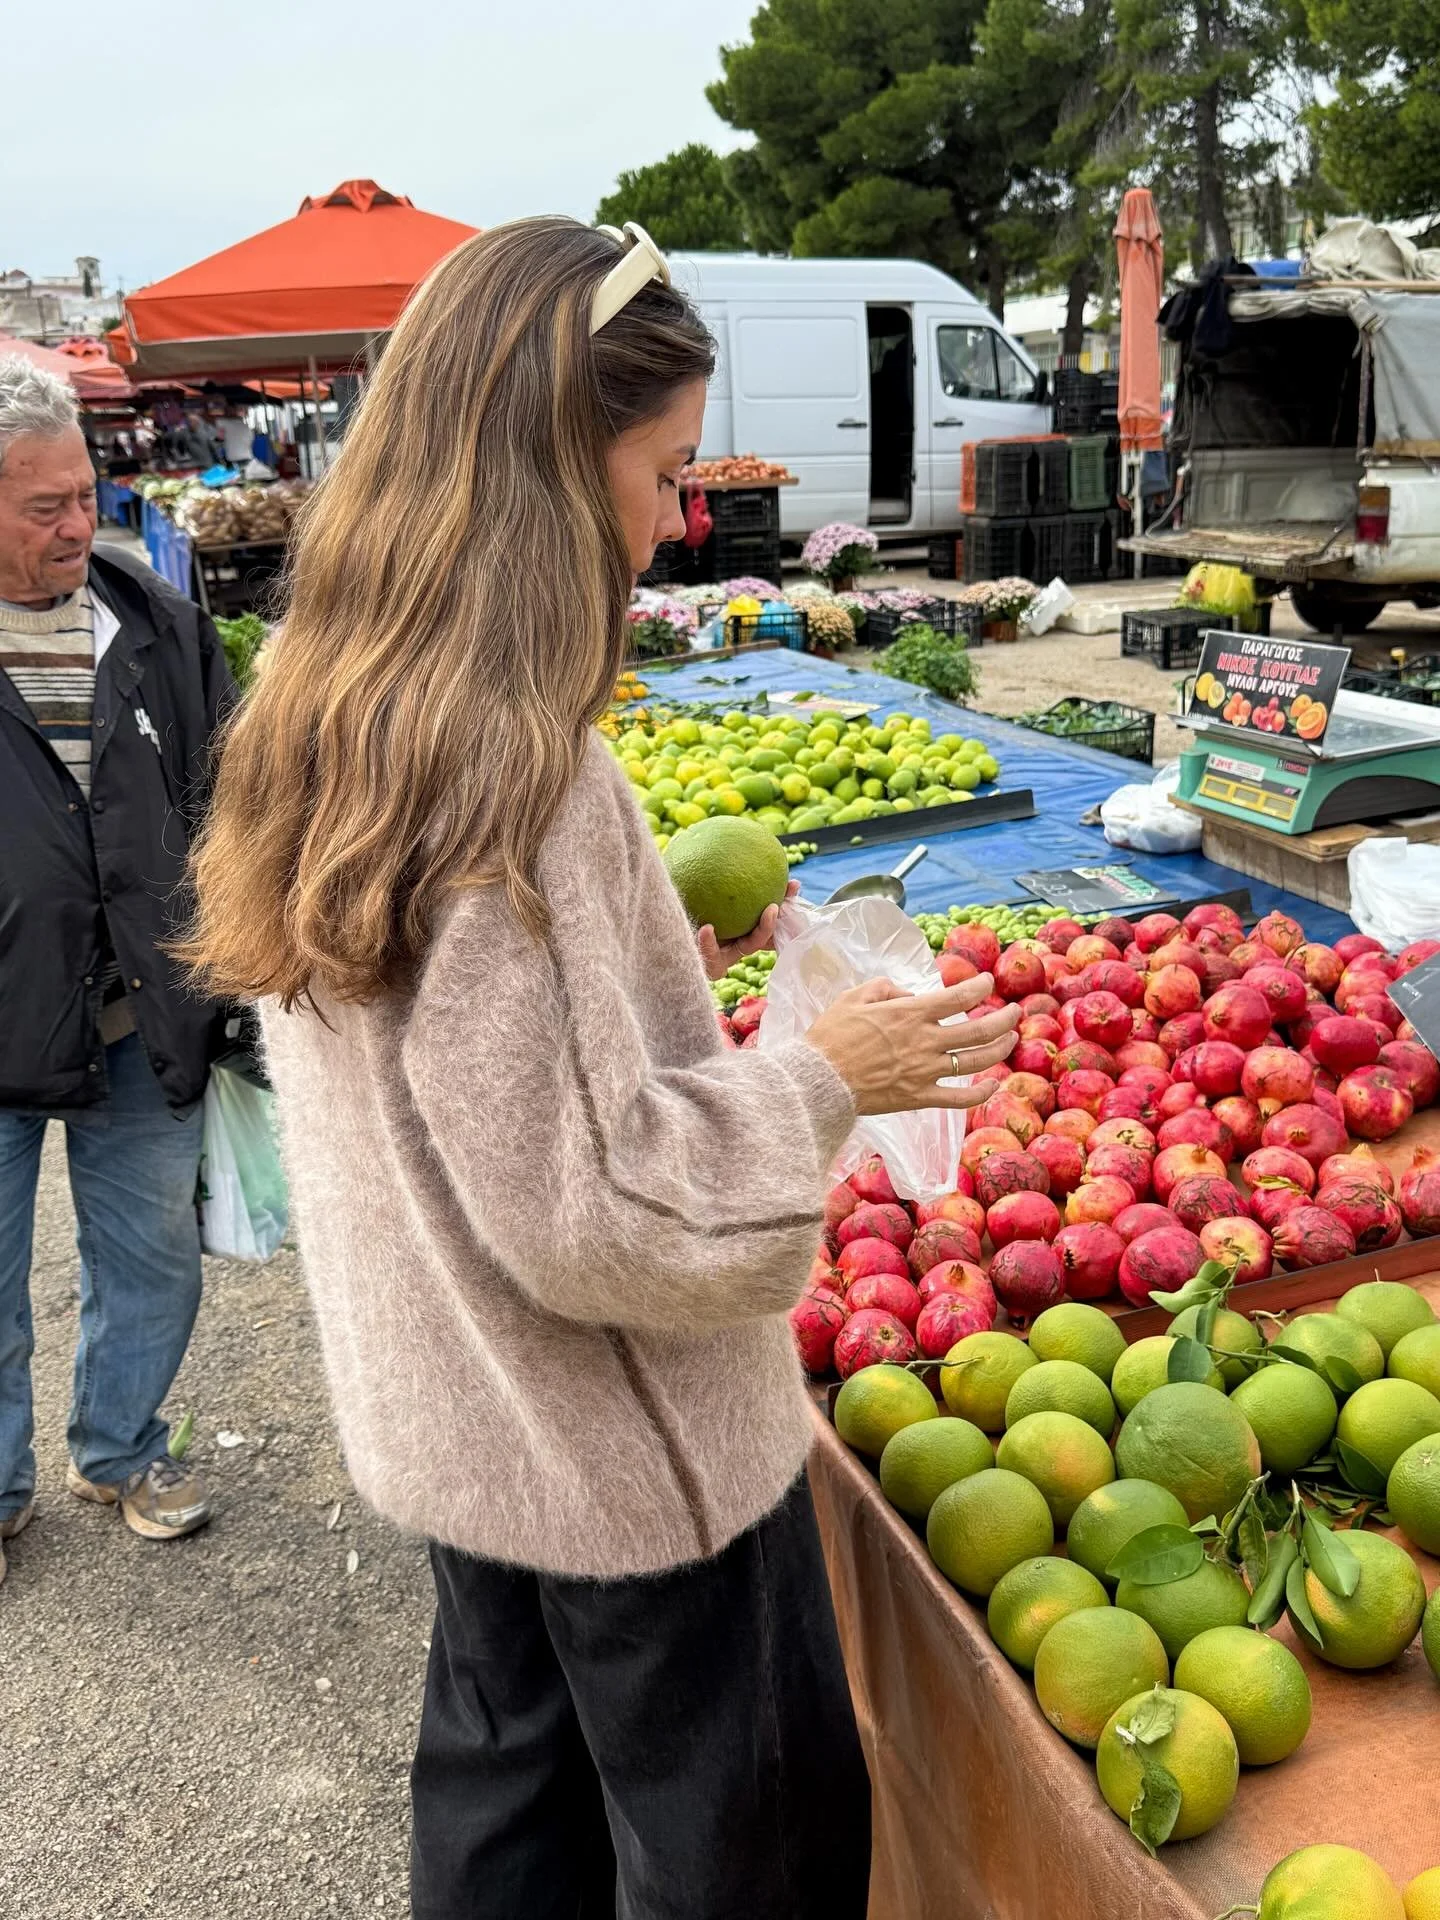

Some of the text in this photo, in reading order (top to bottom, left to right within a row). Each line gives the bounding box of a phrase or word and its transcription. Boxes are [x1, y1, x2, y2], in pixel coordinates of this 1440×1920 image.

[1241, 640, 1304, 661] ΠΑΡΑΓΩΓΟΣ
[1217, 652, 1257, 674] ΝΙΚΟΣ
[1227, 673, 1299, 698] ΜΥΛΟΙ ΑΡΓΟΥΣ
